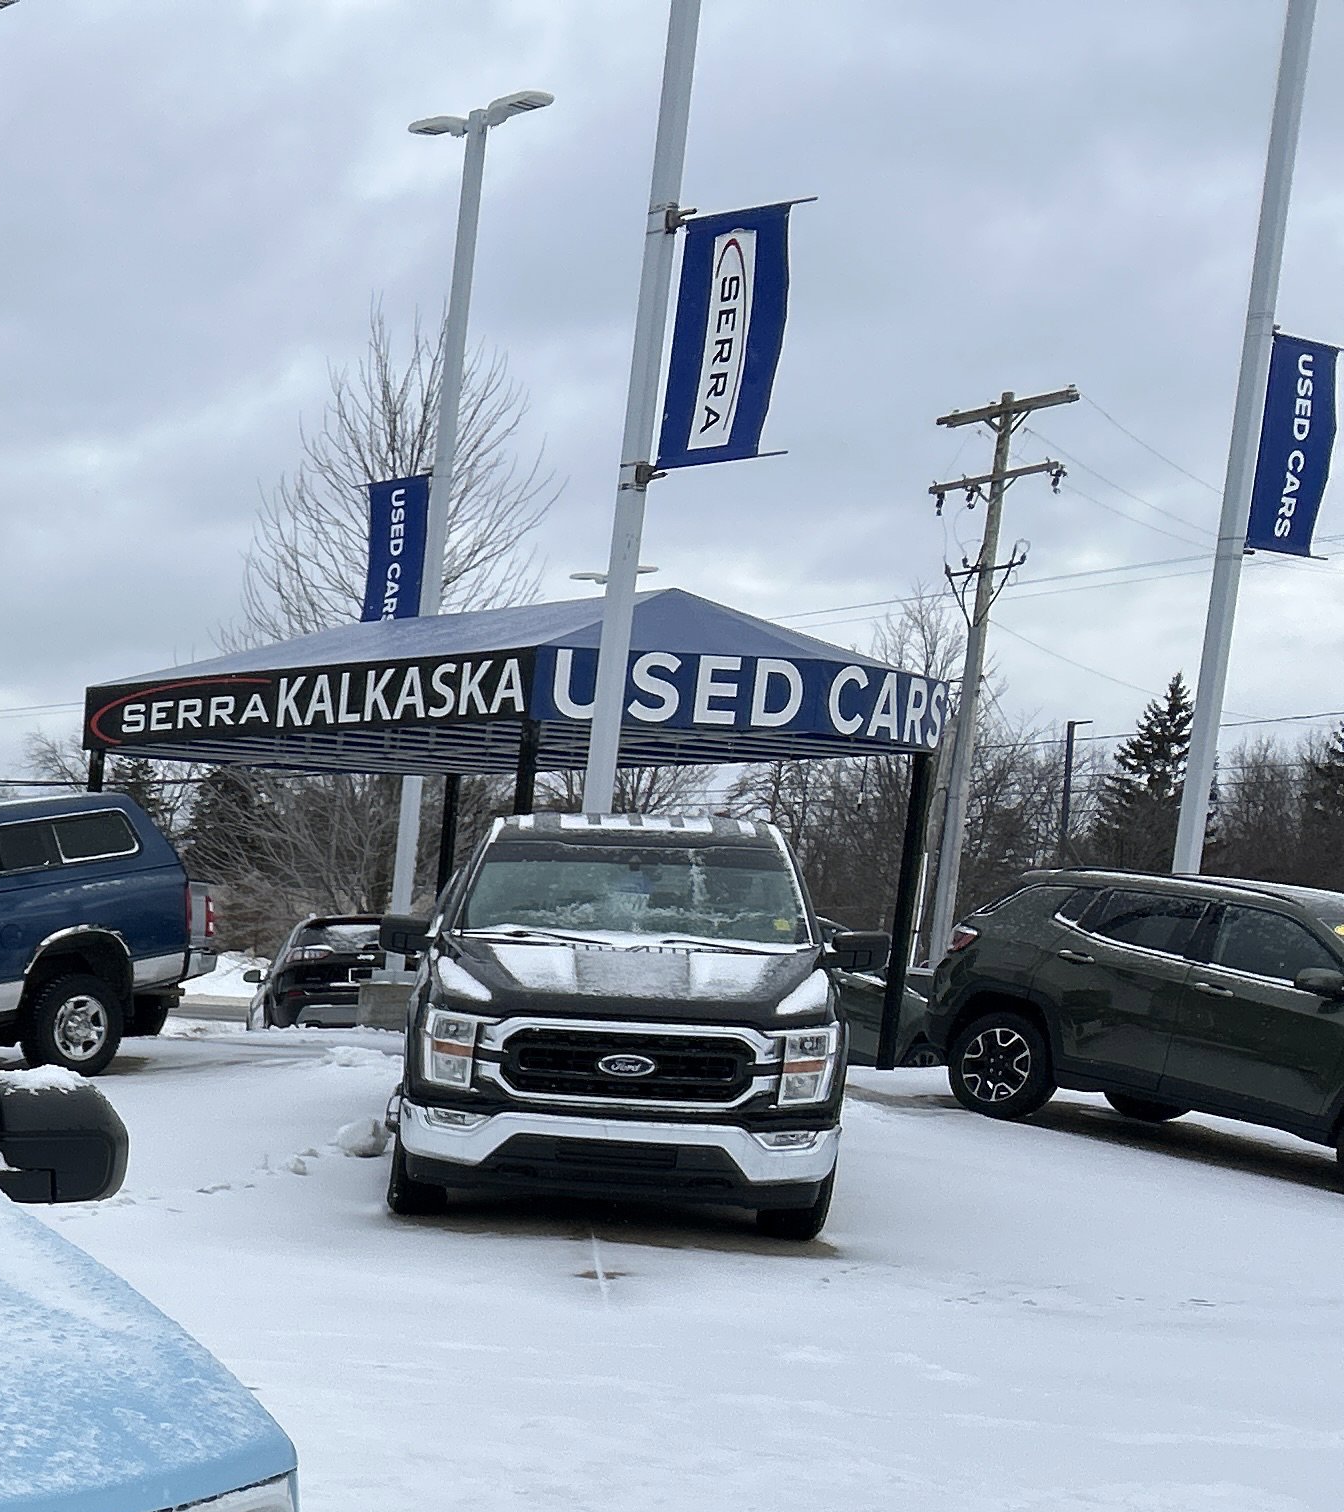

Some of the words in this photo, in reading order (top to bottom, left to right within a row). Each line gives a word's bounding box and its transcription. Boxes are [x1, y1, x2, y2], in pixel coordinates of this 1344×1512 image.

[699, 275, 741, 434] SERRA
[1293, 353, 1314, 441] USED
[390, 488, 405, 556] USED
[1273, 449, 1306, 538] CARS
[121, 693, 270, 733] SERRA
[275, 657, 526, 728] KALKASKA
[553, 649, 804, 728] USED
[828, 665, 947, 749] CARS
[611, 1059, 642, 1071] Ford
